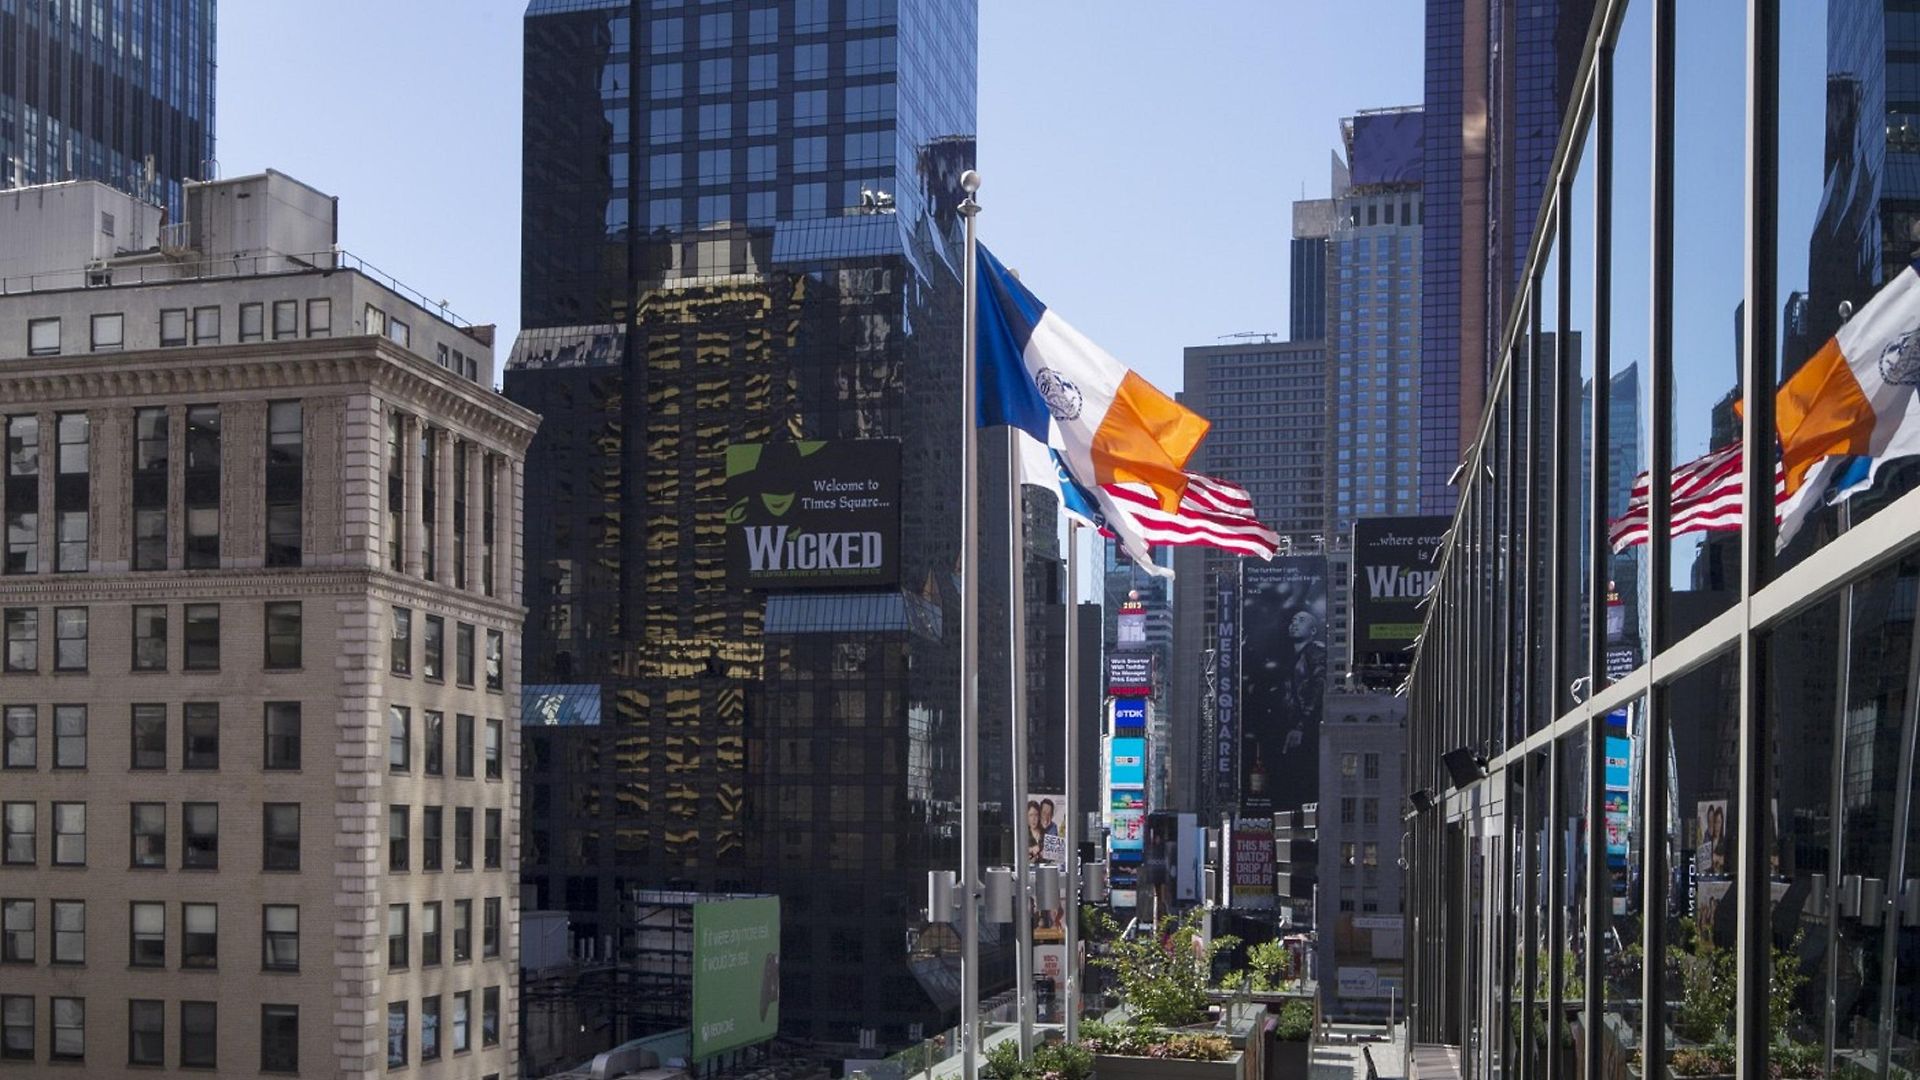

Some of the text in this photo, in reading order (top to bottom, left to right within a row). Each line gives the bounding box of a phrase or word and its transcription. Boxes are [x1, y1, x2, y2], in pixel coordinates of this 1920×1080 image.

[813, 478, 879, 492] Welcome to
[802, 496, 890, 512] Times Square...
[1369, 533, 1413, 547] ...where
[743, 525, 883, 571] WICKED
[1418, 549, 1429, 561] is
[1218, 591, 1233, 668] TIMES
[1124, 709, 1143, 718] TDK
[1217, 678, 1233, 773] SQUARE
[1236, 840, 1273, 850] THIS NE
[1236, 852, 1269, 862] WATCH
[1236, 863, 1261, 873] DROP
[1236, 874, 1261, 884] YOUR
